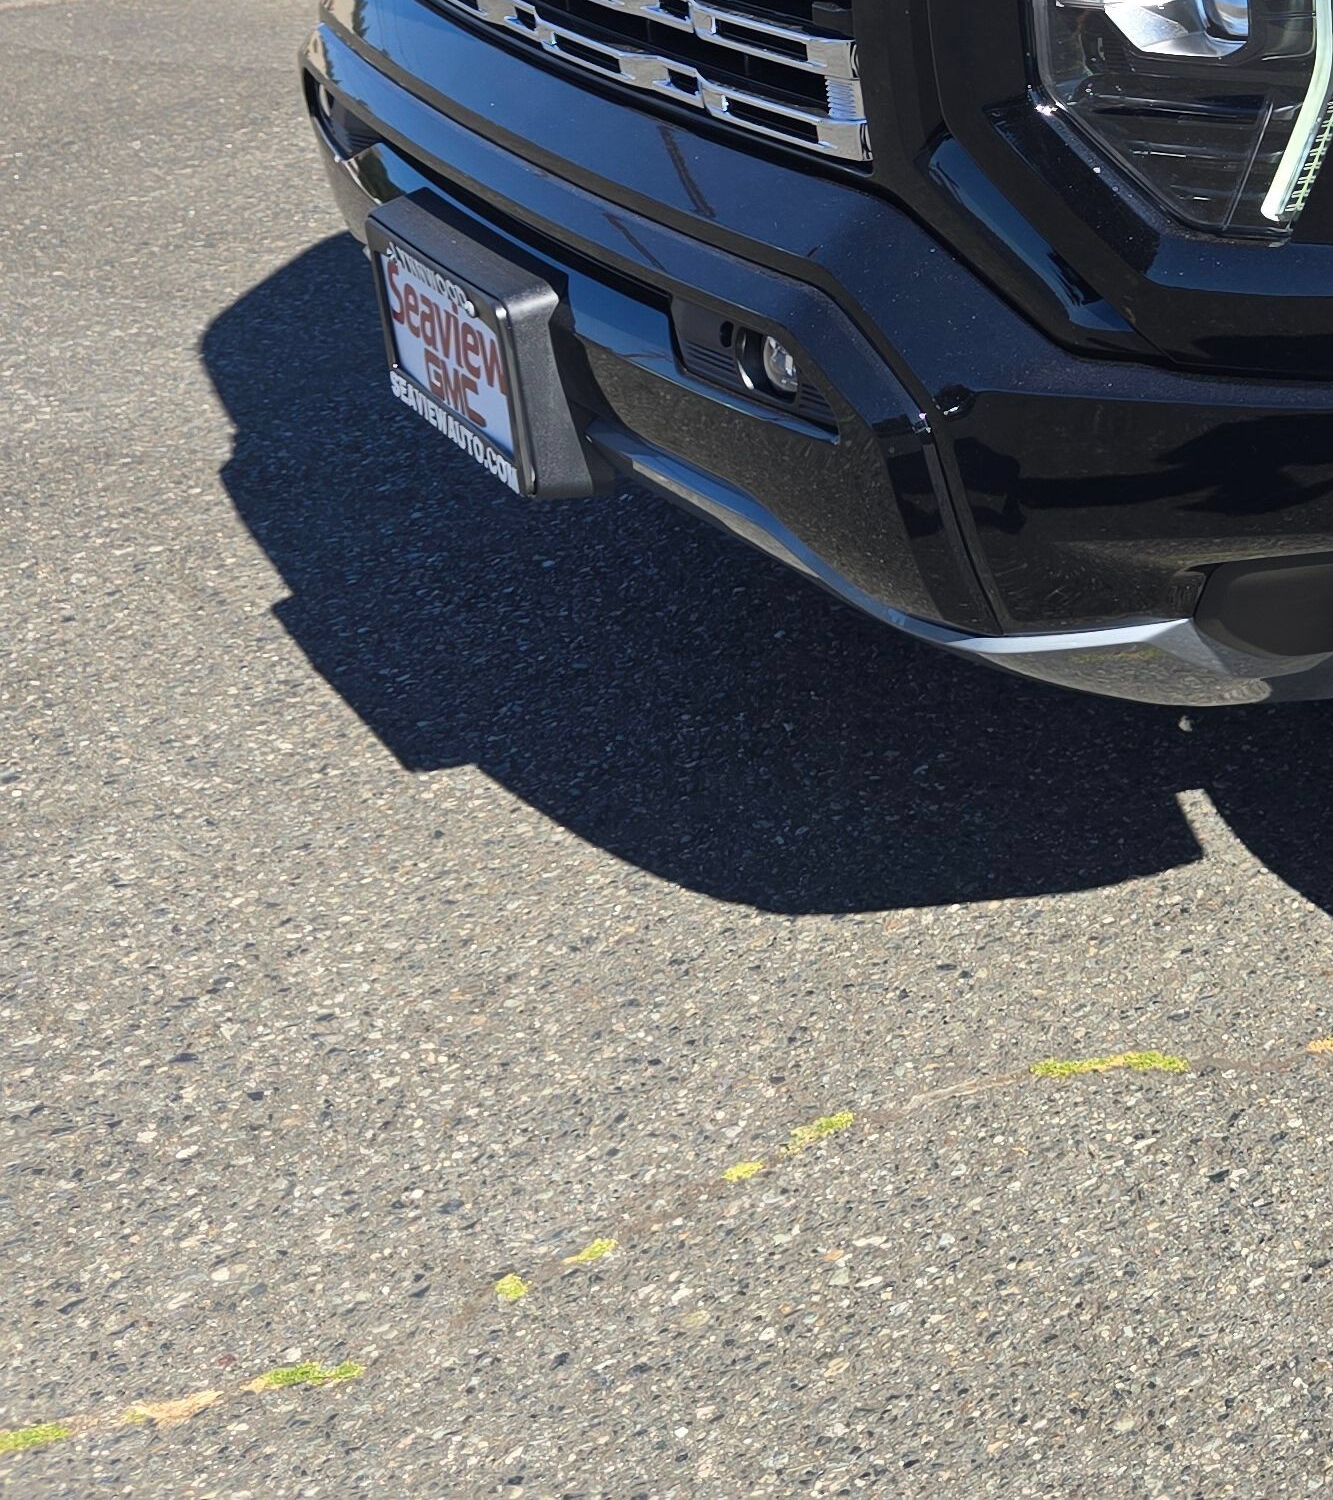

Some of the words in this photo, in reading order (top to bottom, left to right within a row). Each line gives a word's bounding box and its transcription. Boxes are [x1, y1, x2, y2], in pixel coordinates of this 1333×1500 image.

[386, 259, 509, 397] Seaview
[424, 347, 487, 429] GMC
[389, 370, 521, 495] SEAVIEWAUTO.COM
